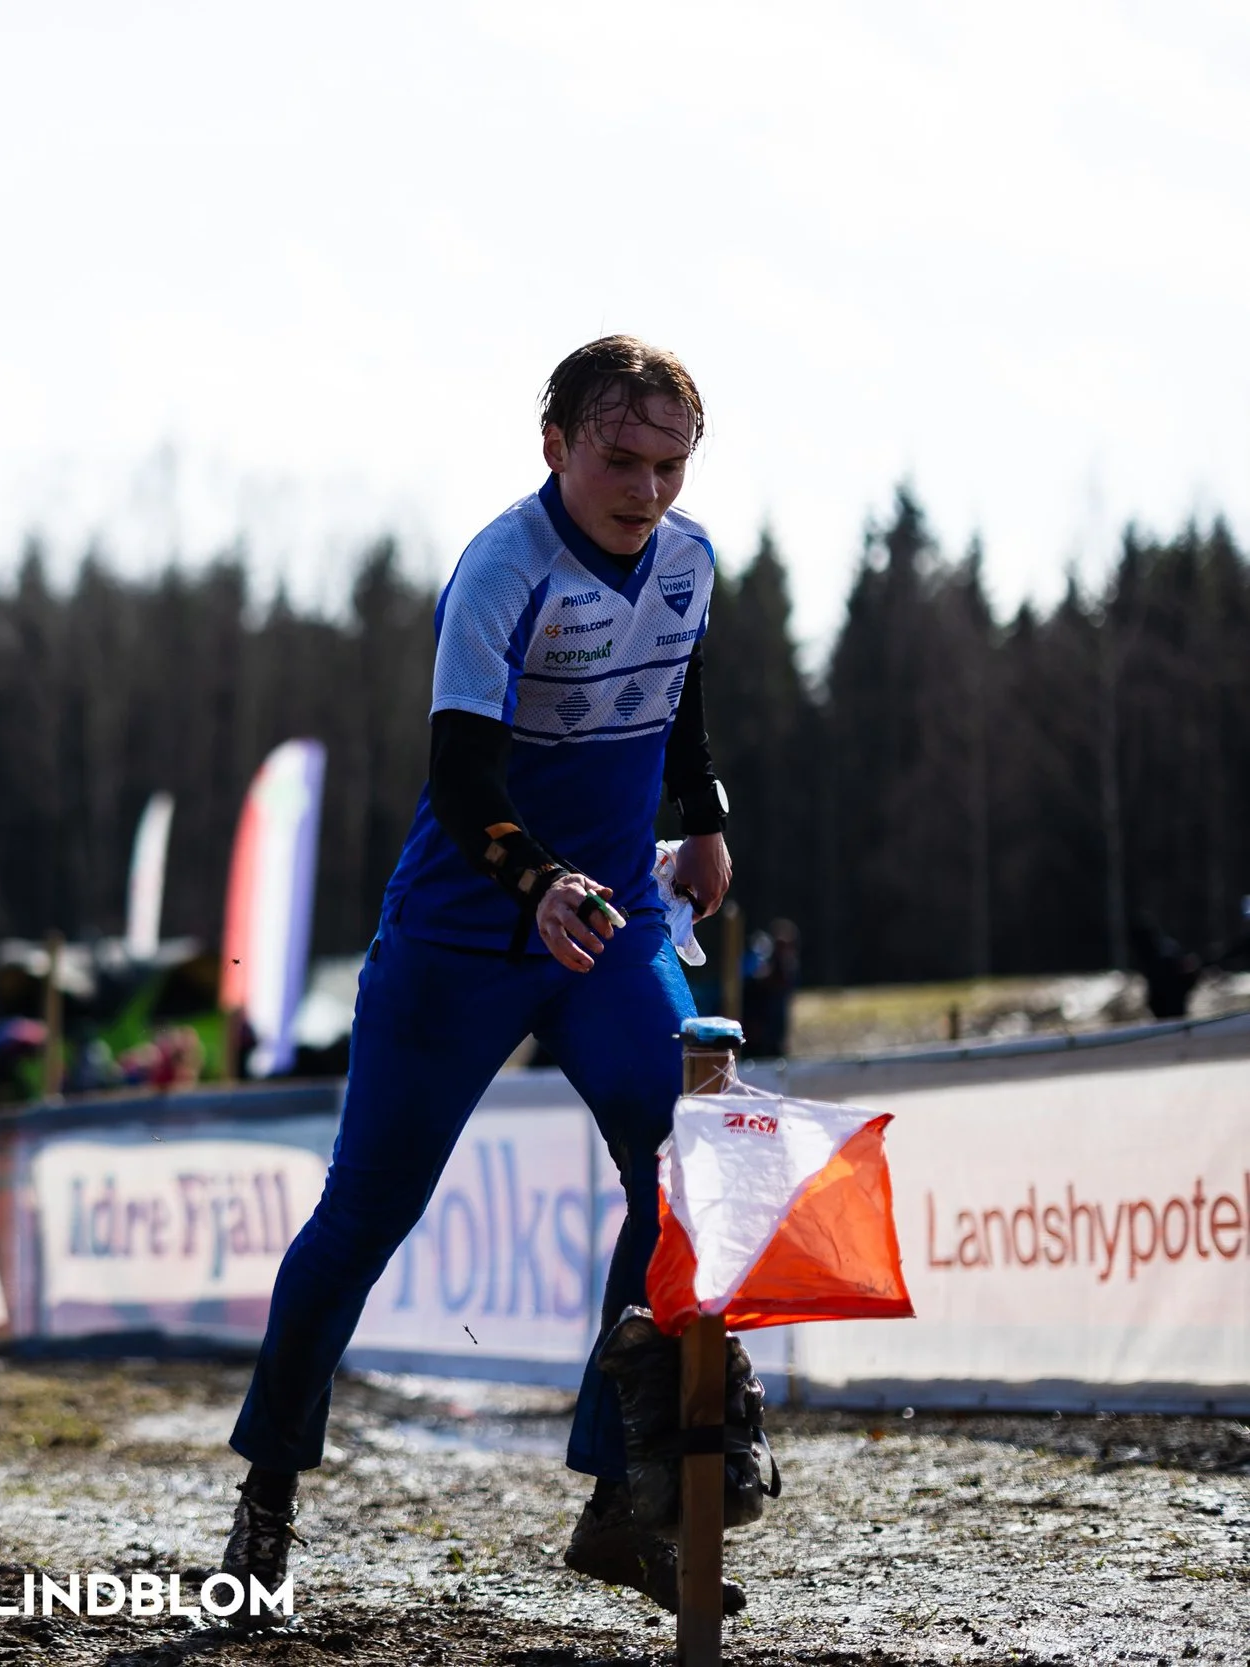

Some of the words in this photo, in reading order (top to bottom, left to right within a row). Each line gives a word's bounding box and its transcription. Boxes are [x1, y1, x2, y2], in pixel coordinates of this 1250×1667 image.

[561, 590, 602, 609] PHILIPS
[562, 618, 614, 635] STEELCOMP
[655, 629, 698, 647] nonam
[67, 1172, 173, 1258] Idre
[176, 1164, 293, 1280] Fjäll
